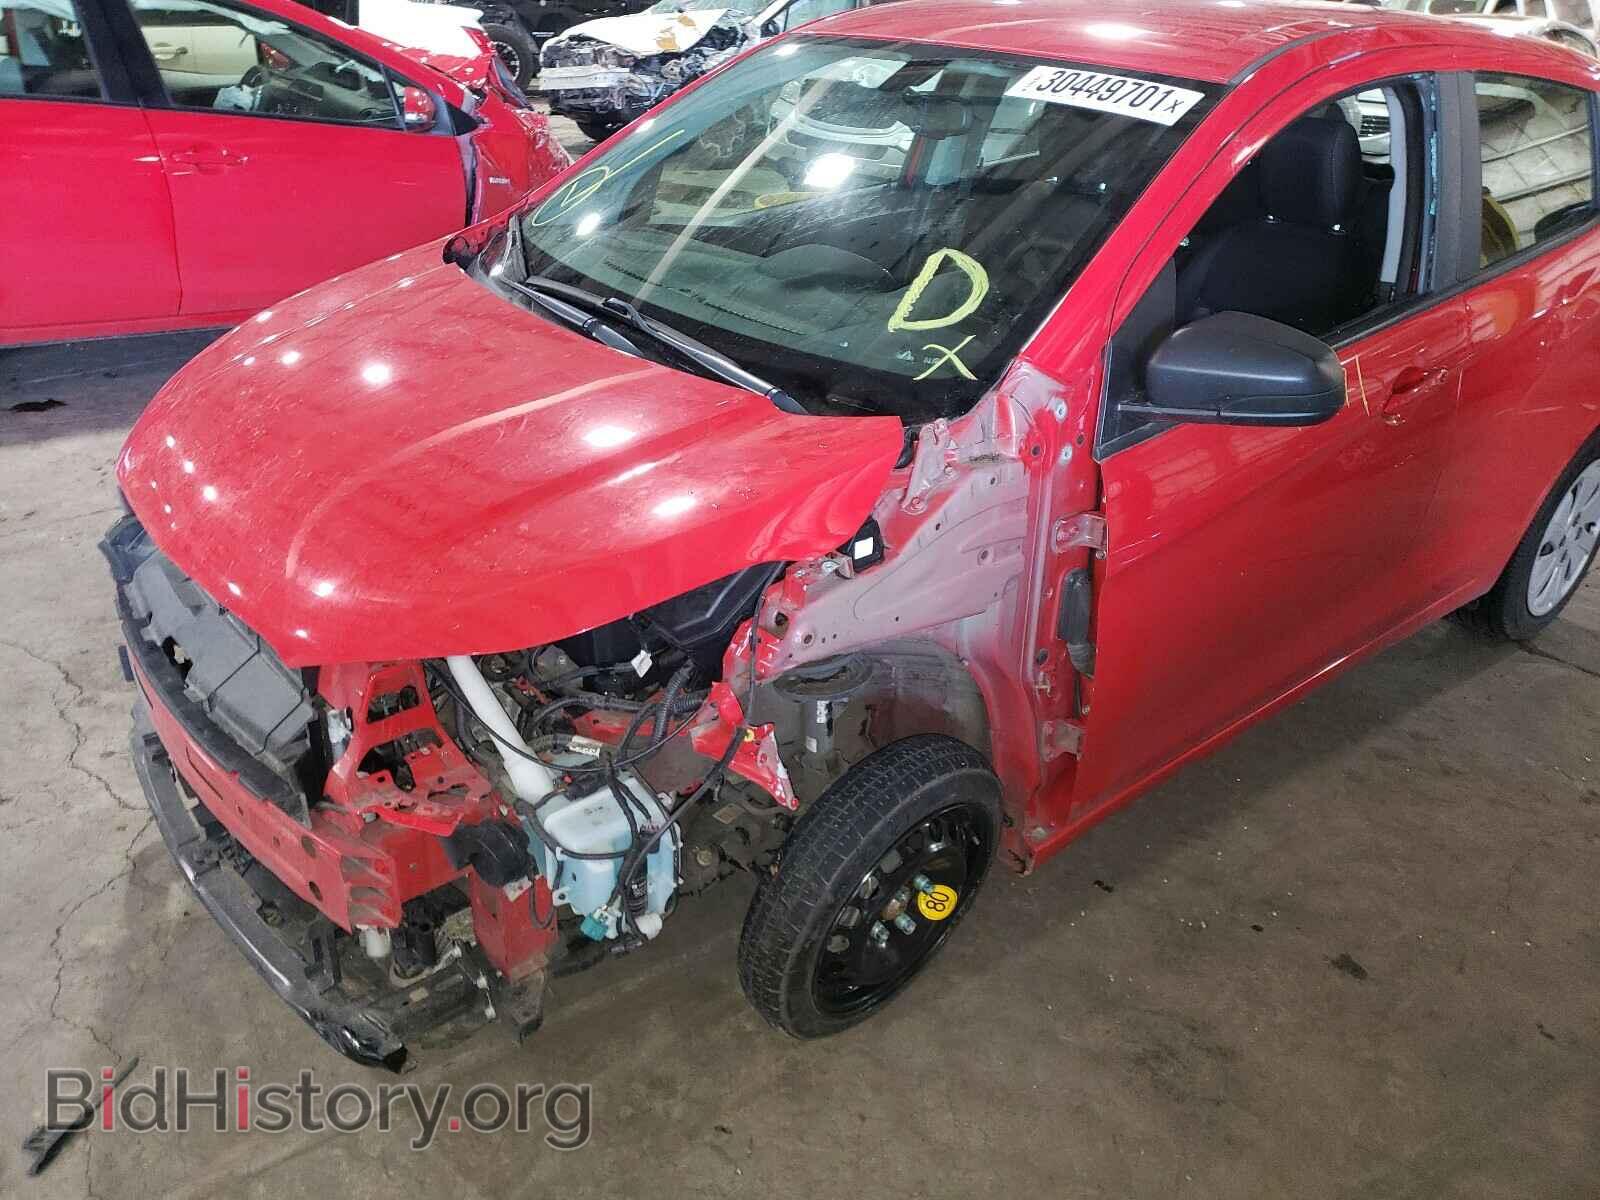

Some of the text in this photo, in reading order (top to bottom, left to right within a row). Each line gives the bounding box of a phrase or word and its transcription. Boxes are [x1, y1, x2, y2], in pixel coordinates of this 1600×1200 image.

[1036, 71, 1174, 111] 30449701
[888, 247, 989, 332] D
[926, 892, 949, 911] 80
